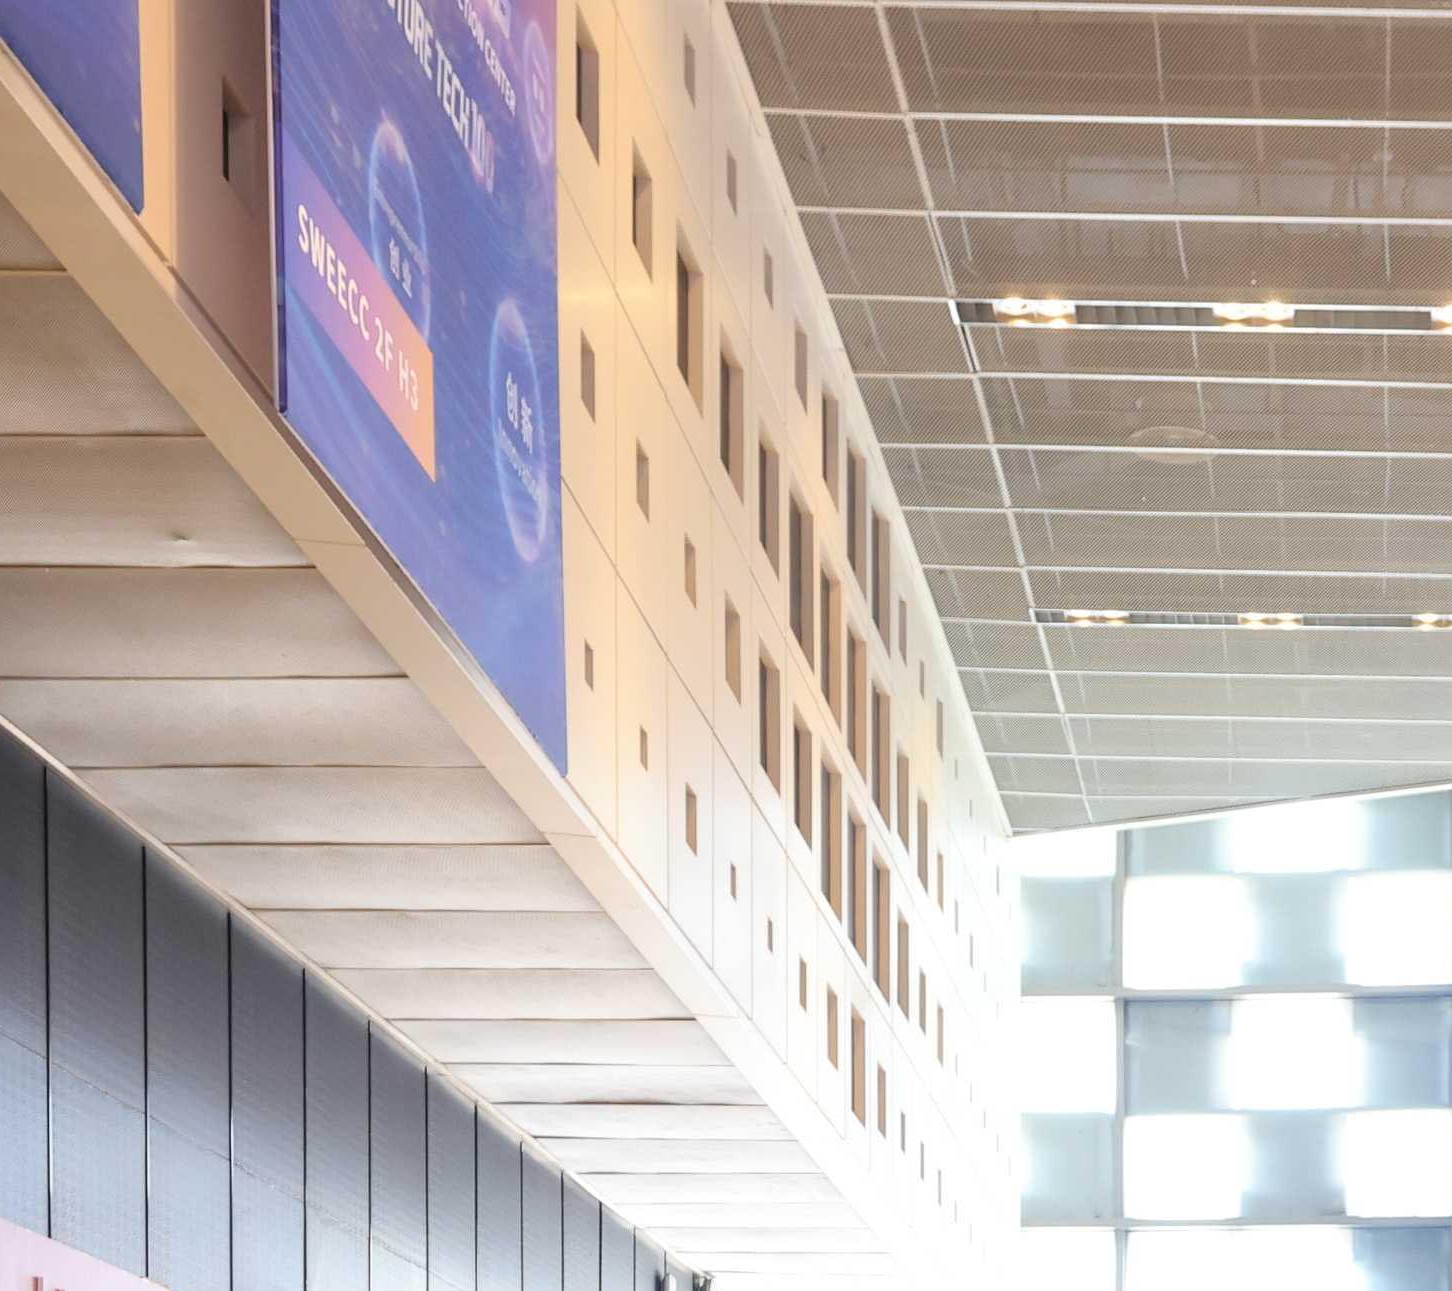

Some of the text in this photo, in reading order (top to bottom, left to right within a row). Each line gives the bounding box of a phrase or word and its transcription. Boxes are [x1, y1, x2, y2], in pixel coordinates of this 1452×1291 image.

[298, 204, 419, 411] SWEECC 2F H3
